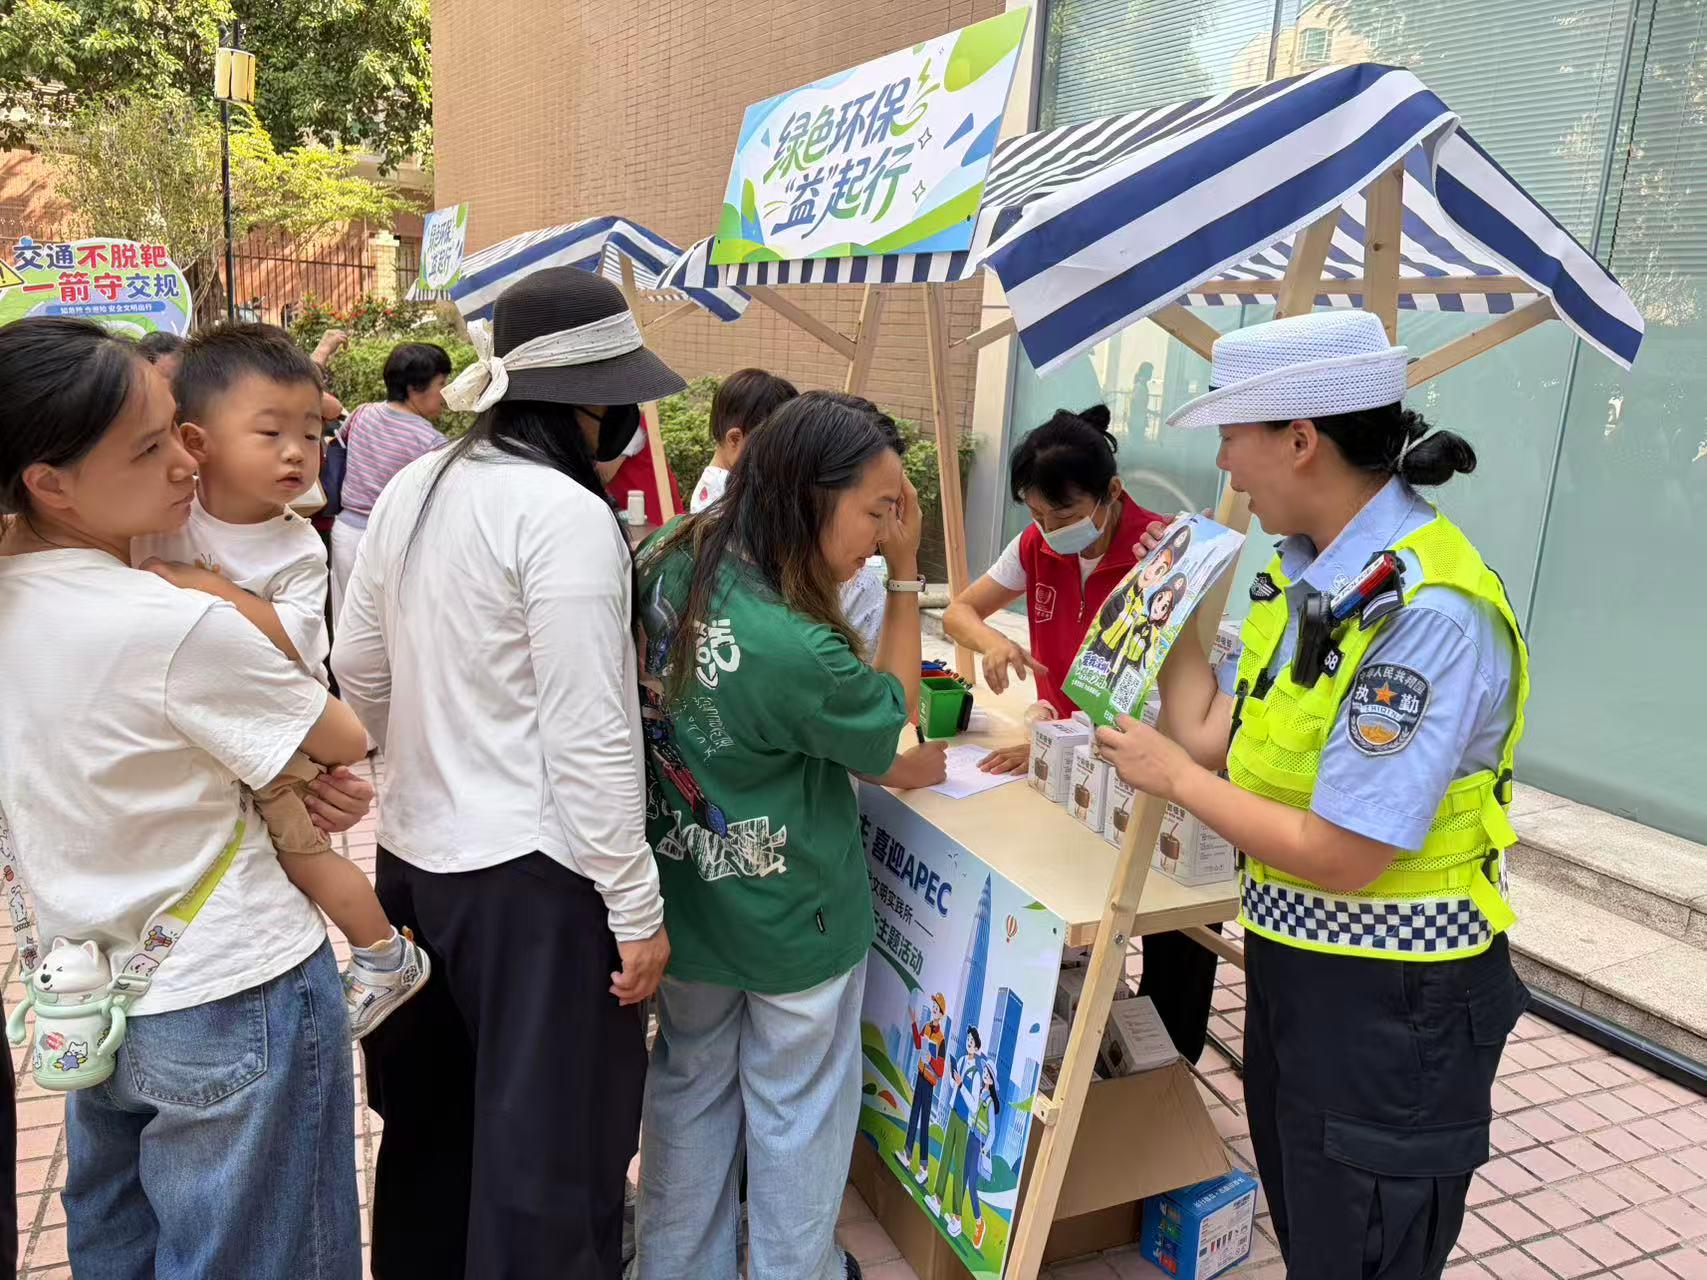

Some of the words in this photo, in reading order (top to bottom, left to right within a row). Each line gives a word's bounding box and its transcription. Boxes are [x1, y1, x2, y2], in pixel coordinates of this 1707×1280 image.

[762, 76, 915, 185] 绿色环保
[13, 242, 169, 272] 交通不脱靶
[22, 271, 180, 302] 一箭守交规
[1359, 666, 1427, 695] 中华人民共和国
